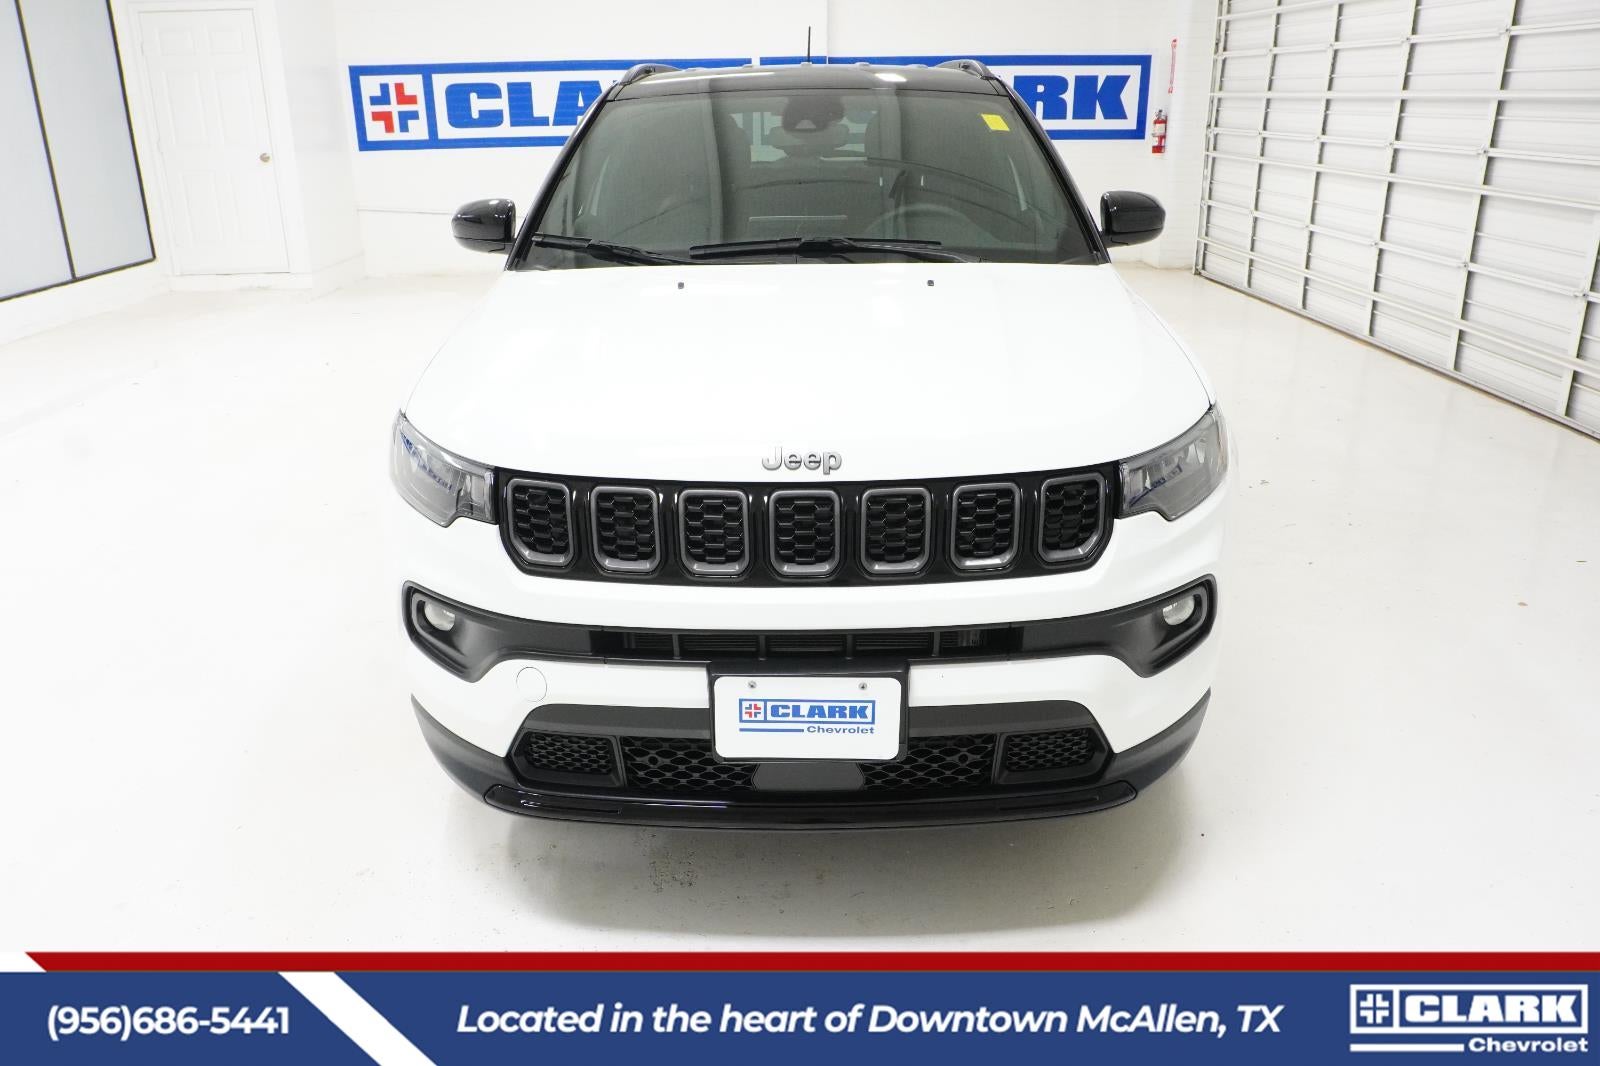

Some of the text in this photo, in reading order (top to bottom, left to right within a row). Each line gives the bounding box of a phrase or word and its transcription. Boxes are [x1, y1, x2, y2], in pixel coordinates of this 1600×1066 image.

[445, 80, 604, 129] CLA
[761, 446, 842, 475] Jeep
[770, 704, 869, 719] CLARK
[806, 725, 875, 735] Chevrolet
